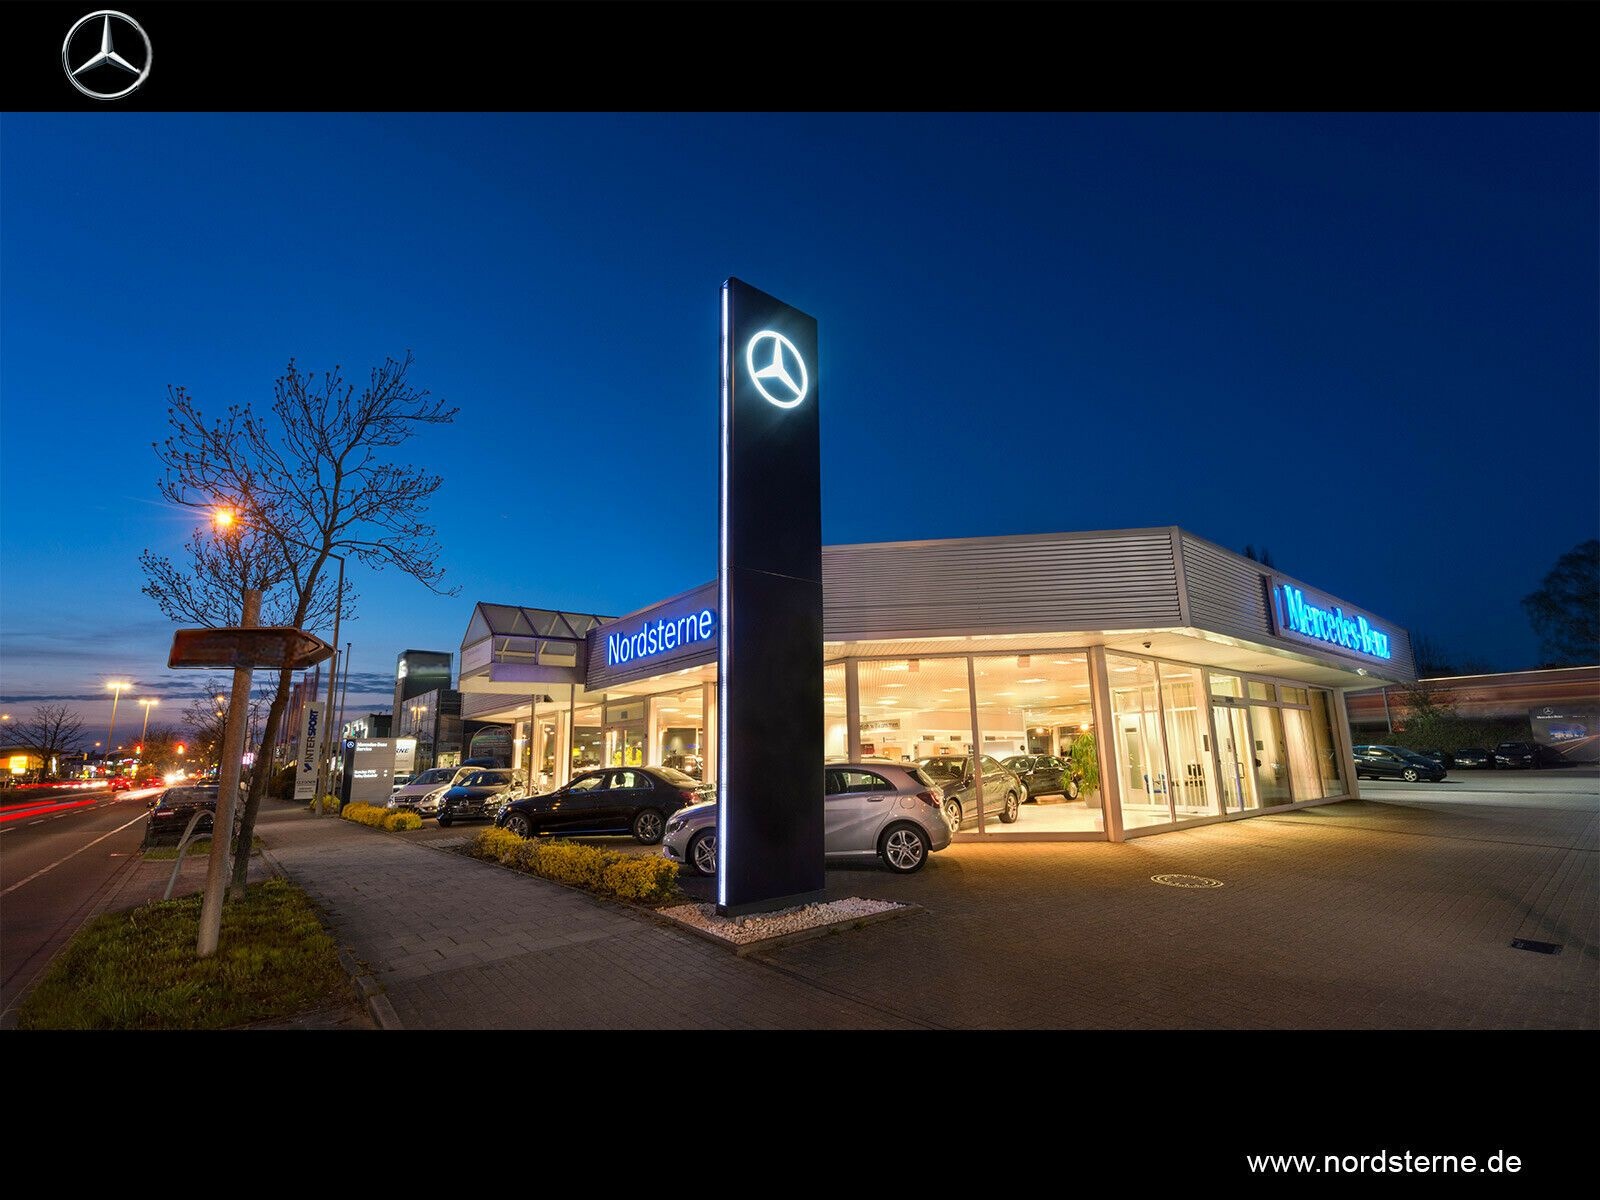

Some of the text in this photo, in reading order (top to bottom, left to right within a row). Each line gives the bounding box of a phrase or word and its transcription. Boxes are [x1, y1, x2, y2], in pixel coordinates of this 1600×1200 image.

[608, 610, 712, 666] Nordsterne
[1284, 584, 1390, 659] Mercedes-Benz
[304, 709, 319, 762] INTERSPORT
